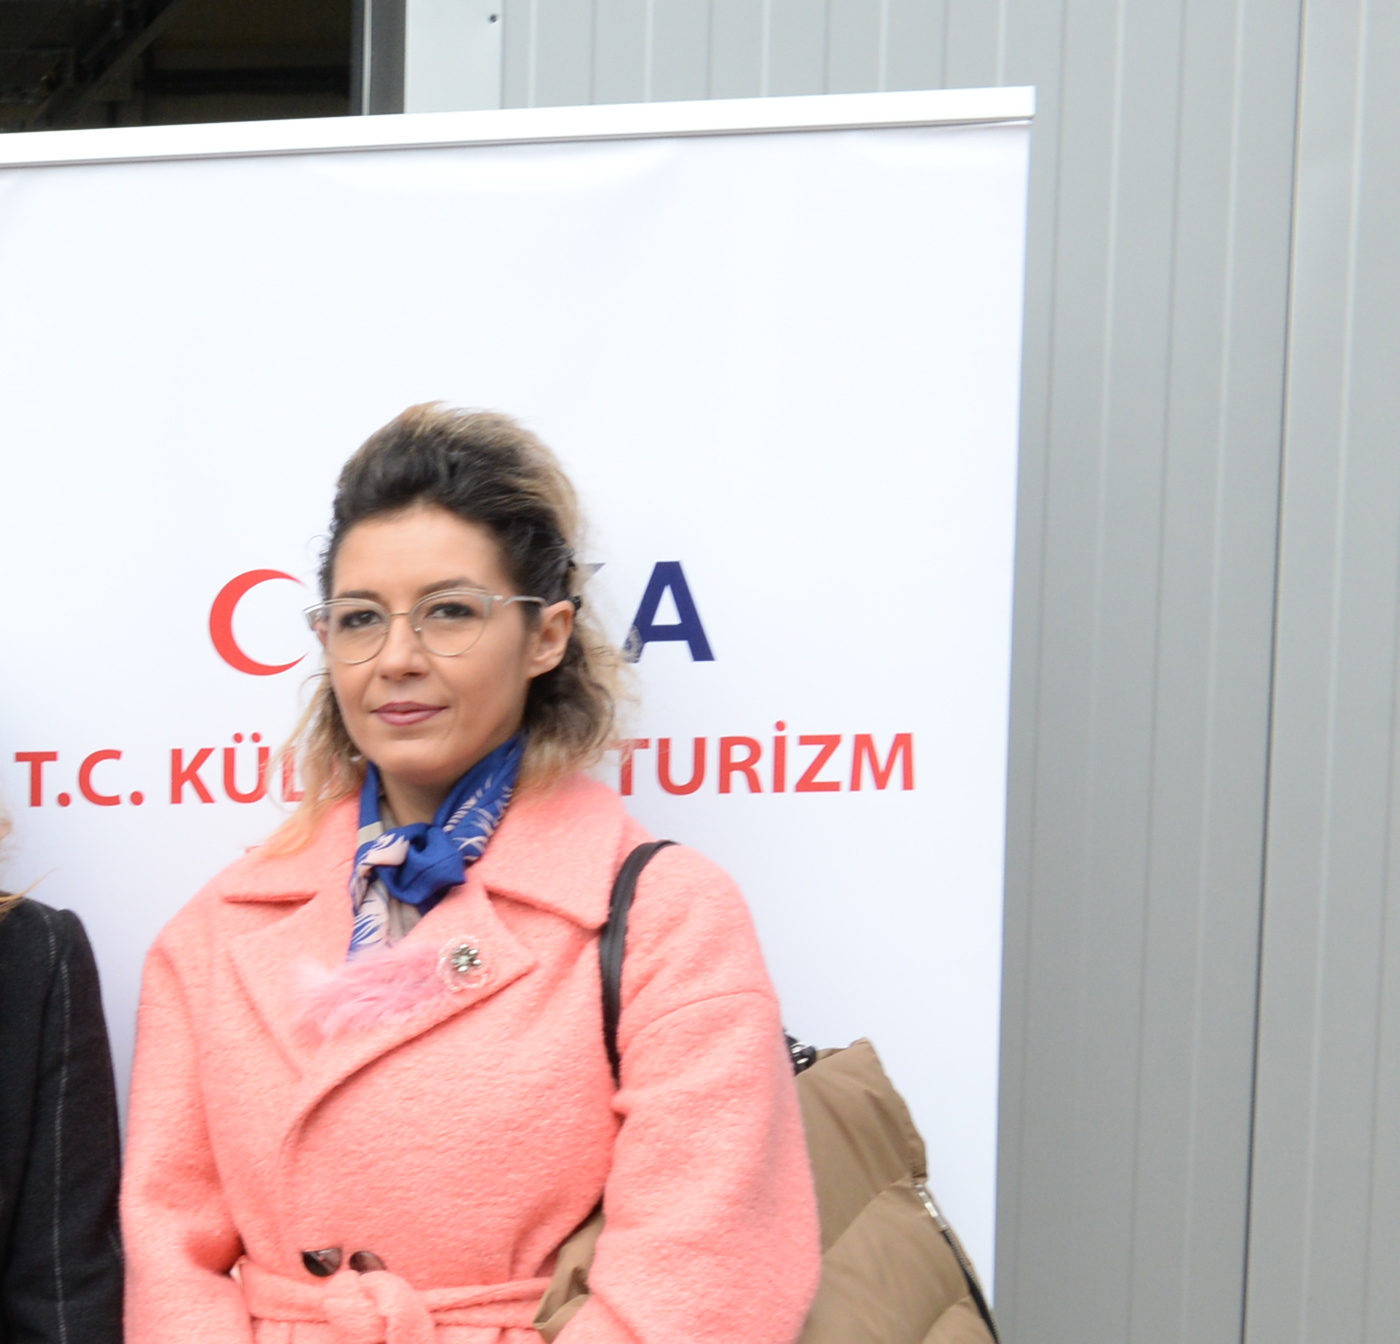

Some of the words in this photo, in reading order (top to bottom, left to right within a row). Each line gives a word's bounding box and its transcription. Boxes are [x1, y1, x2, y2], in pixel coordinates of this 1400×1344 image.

[585, 560, 716, 663] A
[14, 749, 144, 807] T.C.
[170, 732, 307, 805] KÜL
[609, 720, 916, 797] TURİZM
